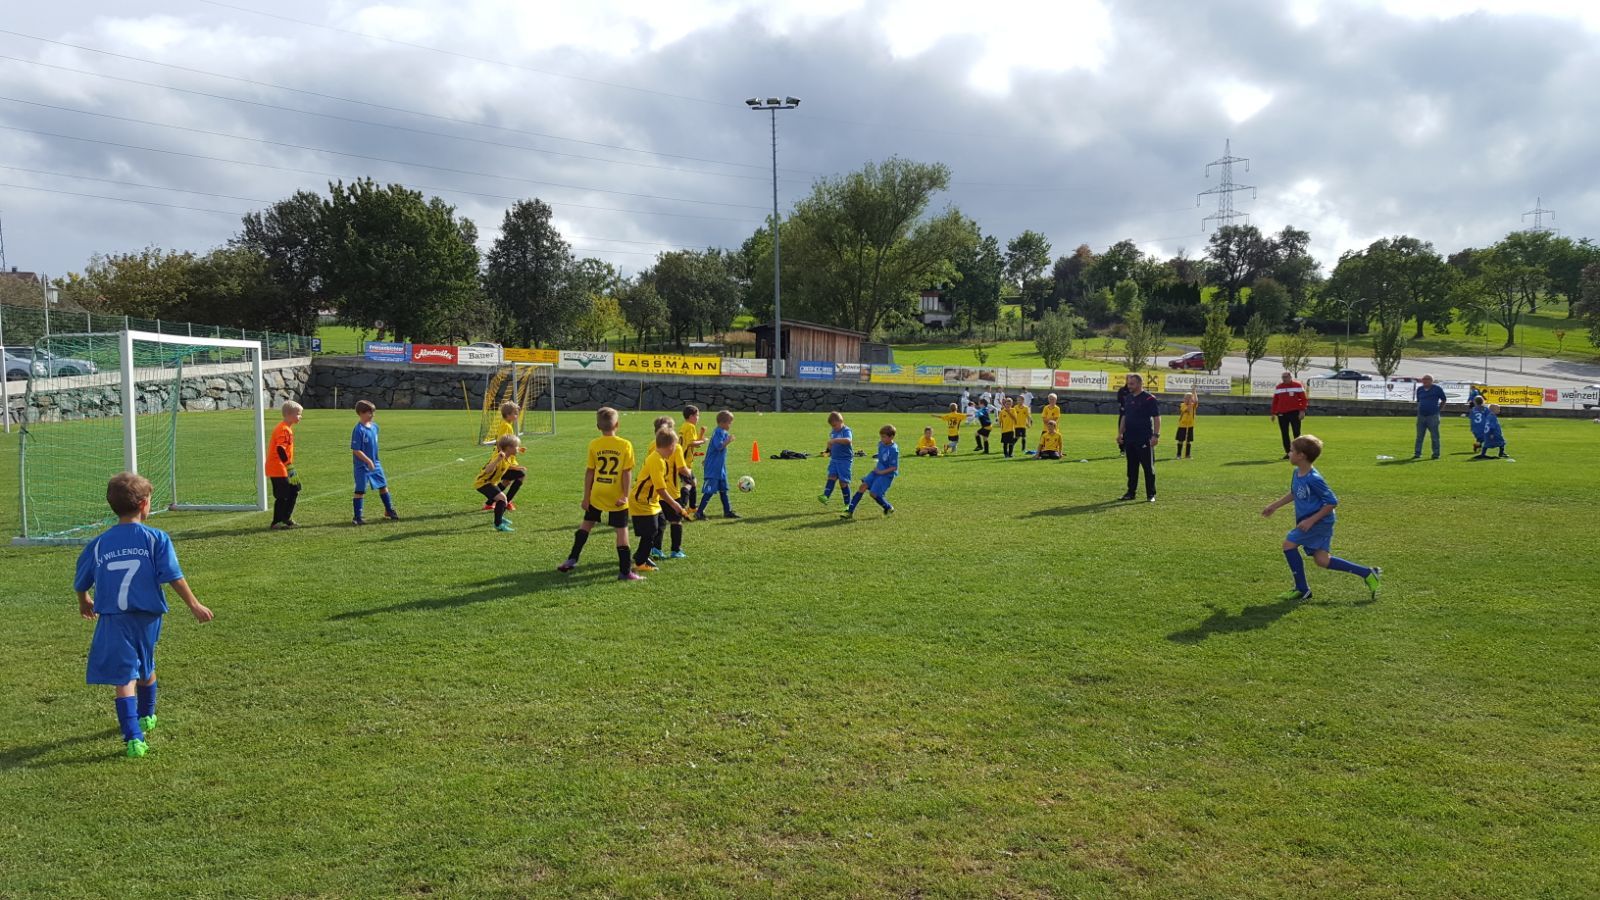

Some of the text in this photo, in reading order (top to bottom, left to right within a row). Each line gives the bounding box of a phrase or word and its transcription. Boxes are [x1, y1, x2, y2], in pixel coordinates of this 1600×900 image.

[312, 339, 320, 348] P
[469, 352, 494, 360] Bauer
[617, 358, 717, 371] LASSMANN
[1071, 375, 1108, 385] weinzetl
[1490, 388, 1542, 397] Raiffeisenbank
[1561, 390, 1598, 400] weinzetl
[1474, 412, 1482, 424] 3
[598, 456, 619, 475] 22
[104, 548, 149, 560] WILLENDOR
[107, 559, 140, 610] 7
